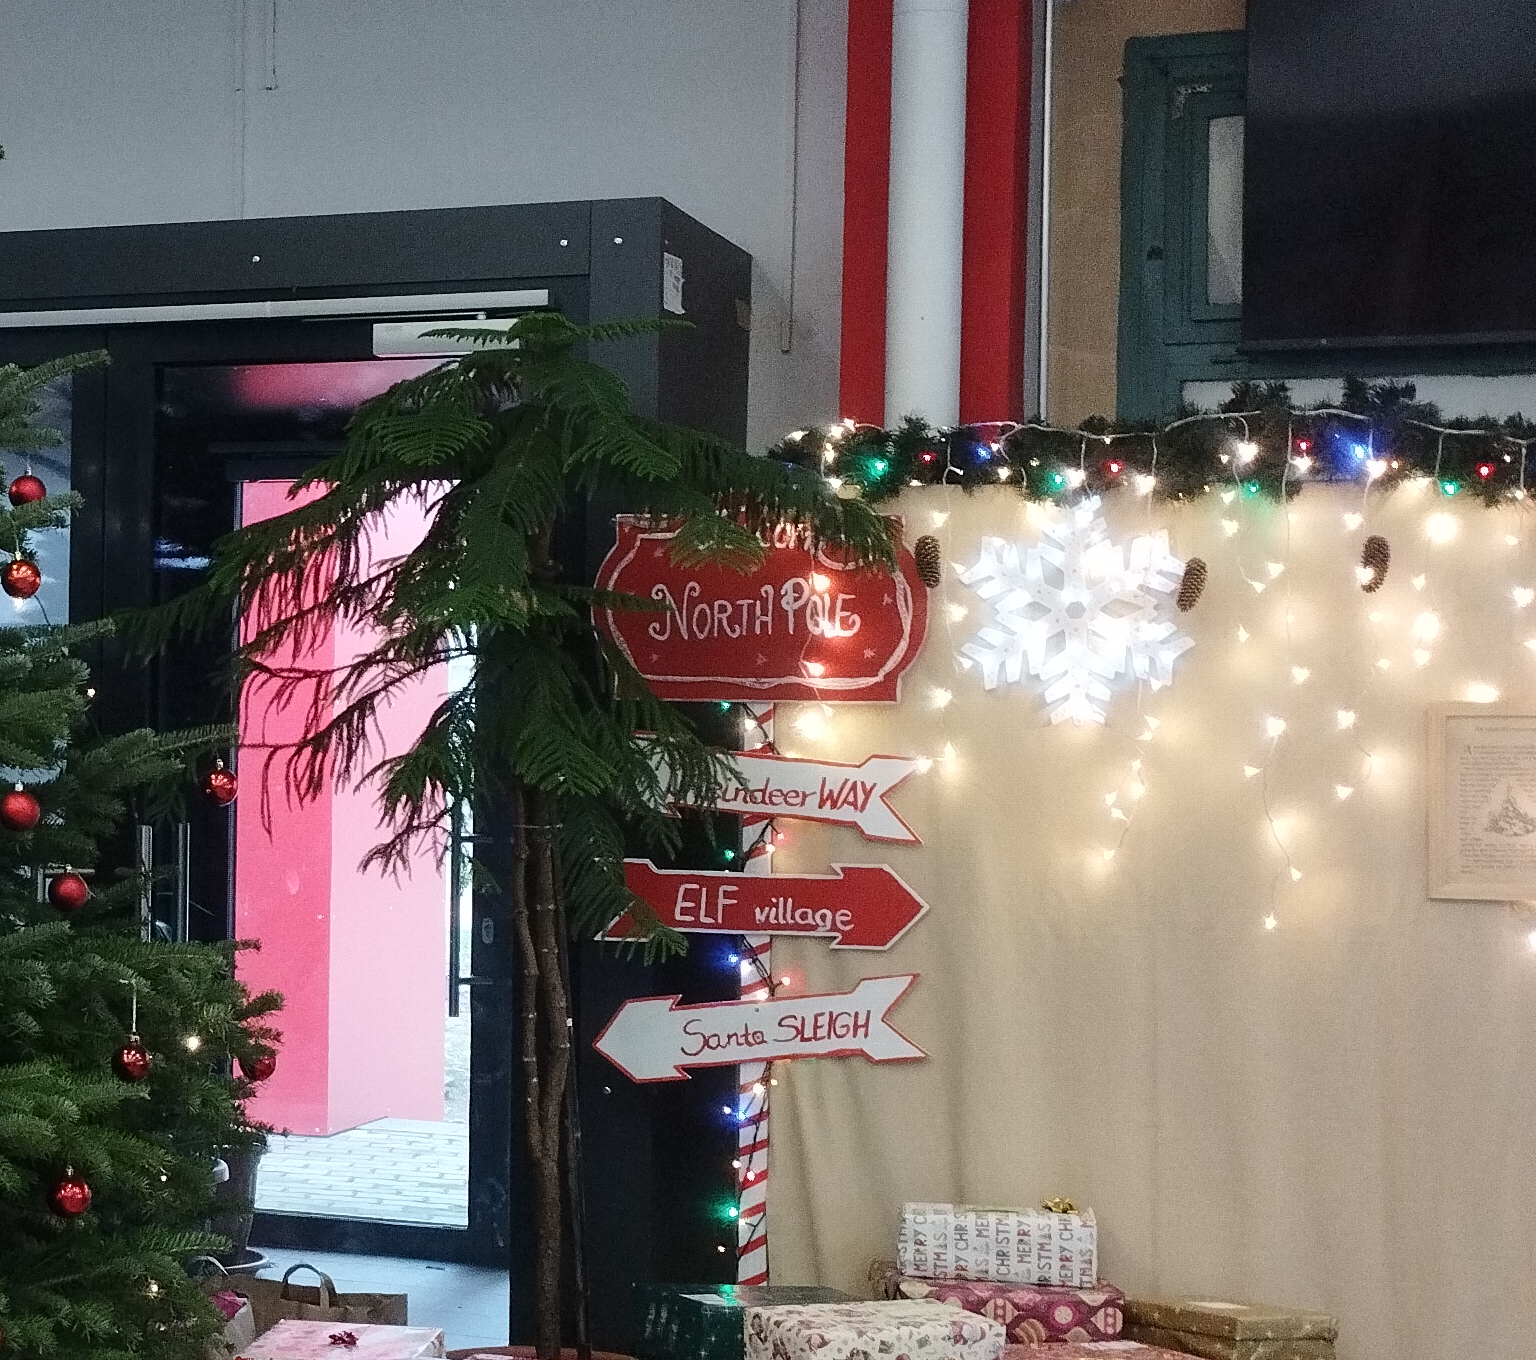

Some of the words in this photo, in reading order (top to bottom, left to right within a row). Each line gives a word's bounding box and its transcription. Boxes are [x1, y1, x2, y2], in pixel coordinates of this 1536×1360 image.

[648, 581, 774, 641] NORTH
[780, 576, 862, 638] POLE
[716, 776, 817, 808] indeer
[817, 776, 878, 814] WAY
[674, 883, 740, 925] ELF
[754, 897, 855, 933] village
[680, 1018, 769, 1056] Santa
[772, 1009, 872, 1042] SLEIGH
